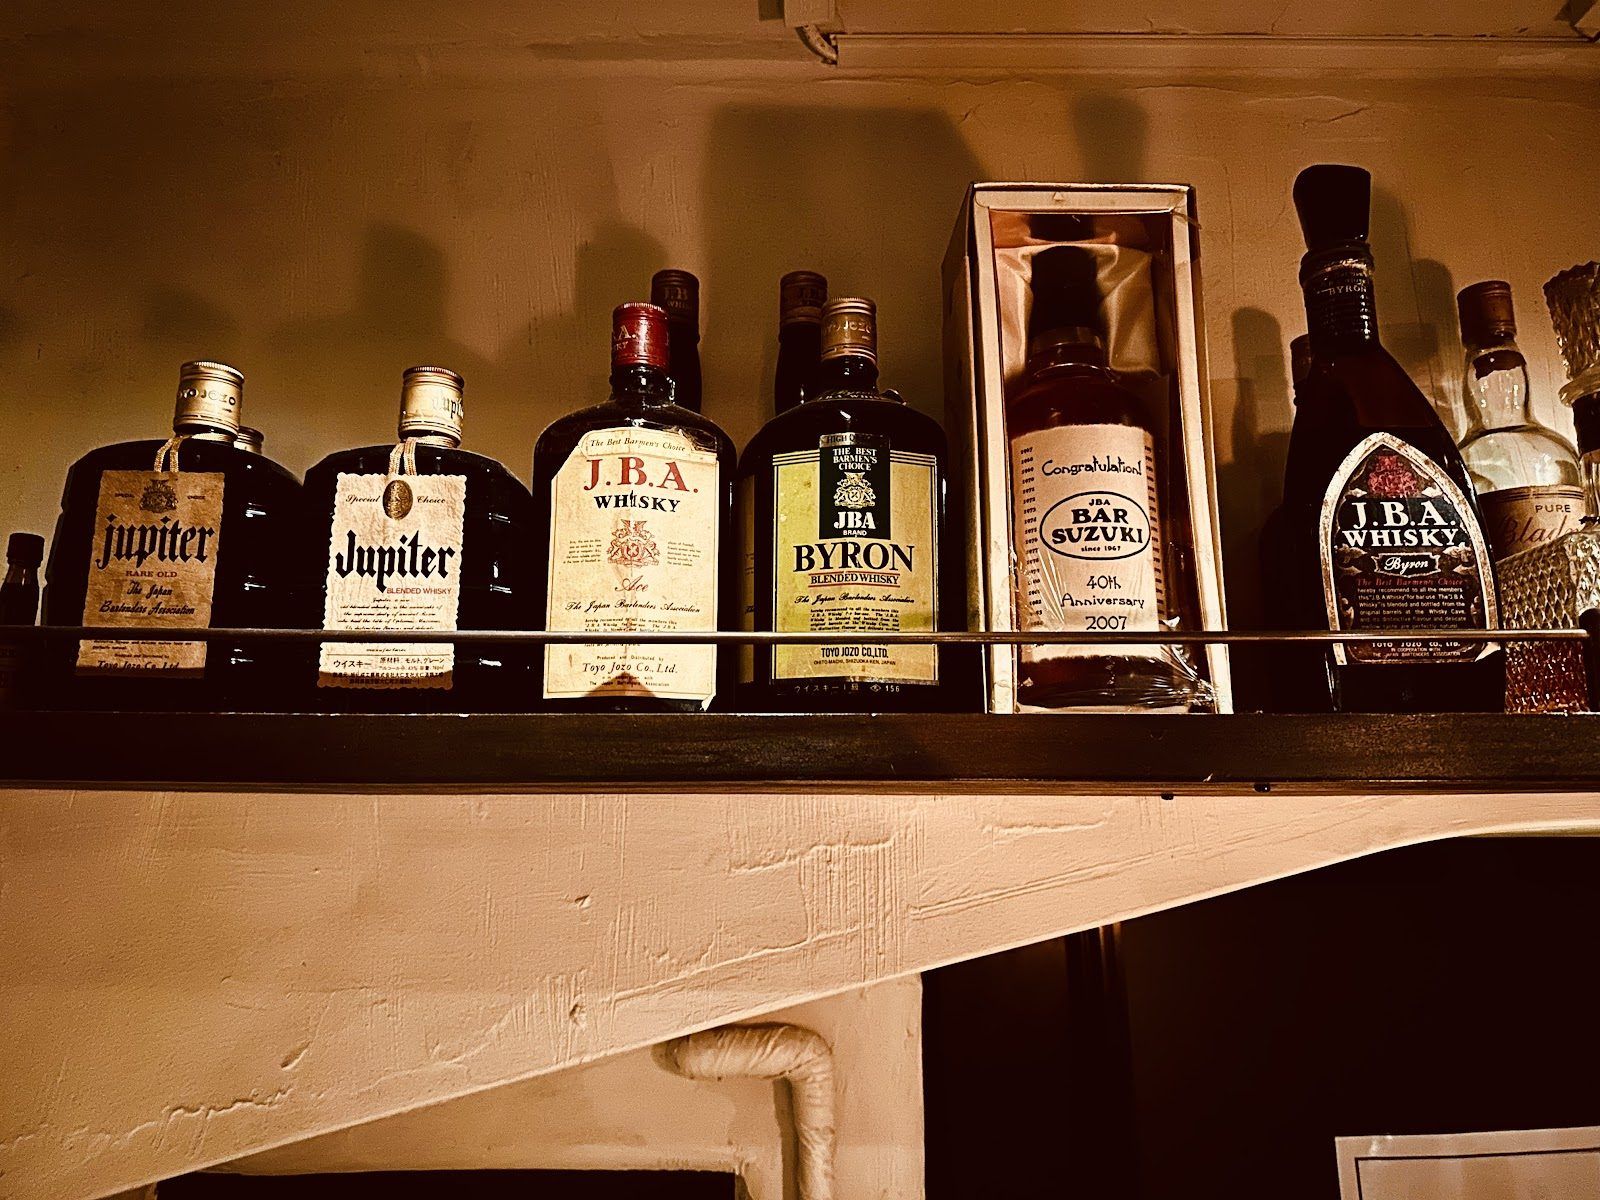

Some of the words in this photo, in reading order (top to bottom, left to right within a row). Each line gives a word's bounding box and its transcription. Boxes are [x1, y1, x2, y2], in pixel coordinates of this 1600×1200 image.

[590, 439, 603, 447] The
[607, 438, 621, 446] Best
[662, 442, 686, 452] Choice
[832, 447, 850, 455] THE
[855, 447, 877, 456] BEST
[833, 455, 878, 464] BARMEN'S
[838, 462, 872, 471] CHOICE
[345, 494, 381, 505] Special
[417, 496, 446, 504] Choice
[594, 490, 681, 513] WHISKY
[1088, 498, 1111, 507] JBA
[1535, 504, 1571, 513] PURE
[833, 511, 876, 529] JBA
[1071, 508, 1129, 524] BAR
[843, 529, 868, 537] BRAND
[1051, 526, 1143, 544] SUZUKI
[1342, 528, 1459, 547] WHISKY
[95, 513, 215, 570] jupiter
[335, 529, 456, 593] Jupiter
[793, 541, 915, 573] BYRON
[1383, 556, 1429, 575] Byron
[125, 570, 153, 578] RARE
[810, 573, 860, 585] BLENDED
[860, 574, 900, 585] WHISKY
[1086, 575, 1122, 590] 40th
[794, 596, 810, 604] The
[812, 593, 835, 605] Japan
[1061, 592, 1145, 609] Anniversary
[565, 602, 582, 610] The
[584, 601, 610, 613] Japan
[1085, 616, 1128, 631] 2007
[821, 647, 840, 658] TOYO
[841, 647, 860, 657] JOZO
[333, 660, 372, 669] ウイスキー
[582, 662, 606, 675] Toyo
[608, 661, 632, 674] Jozo
[886, 684, 900, 693] 156
